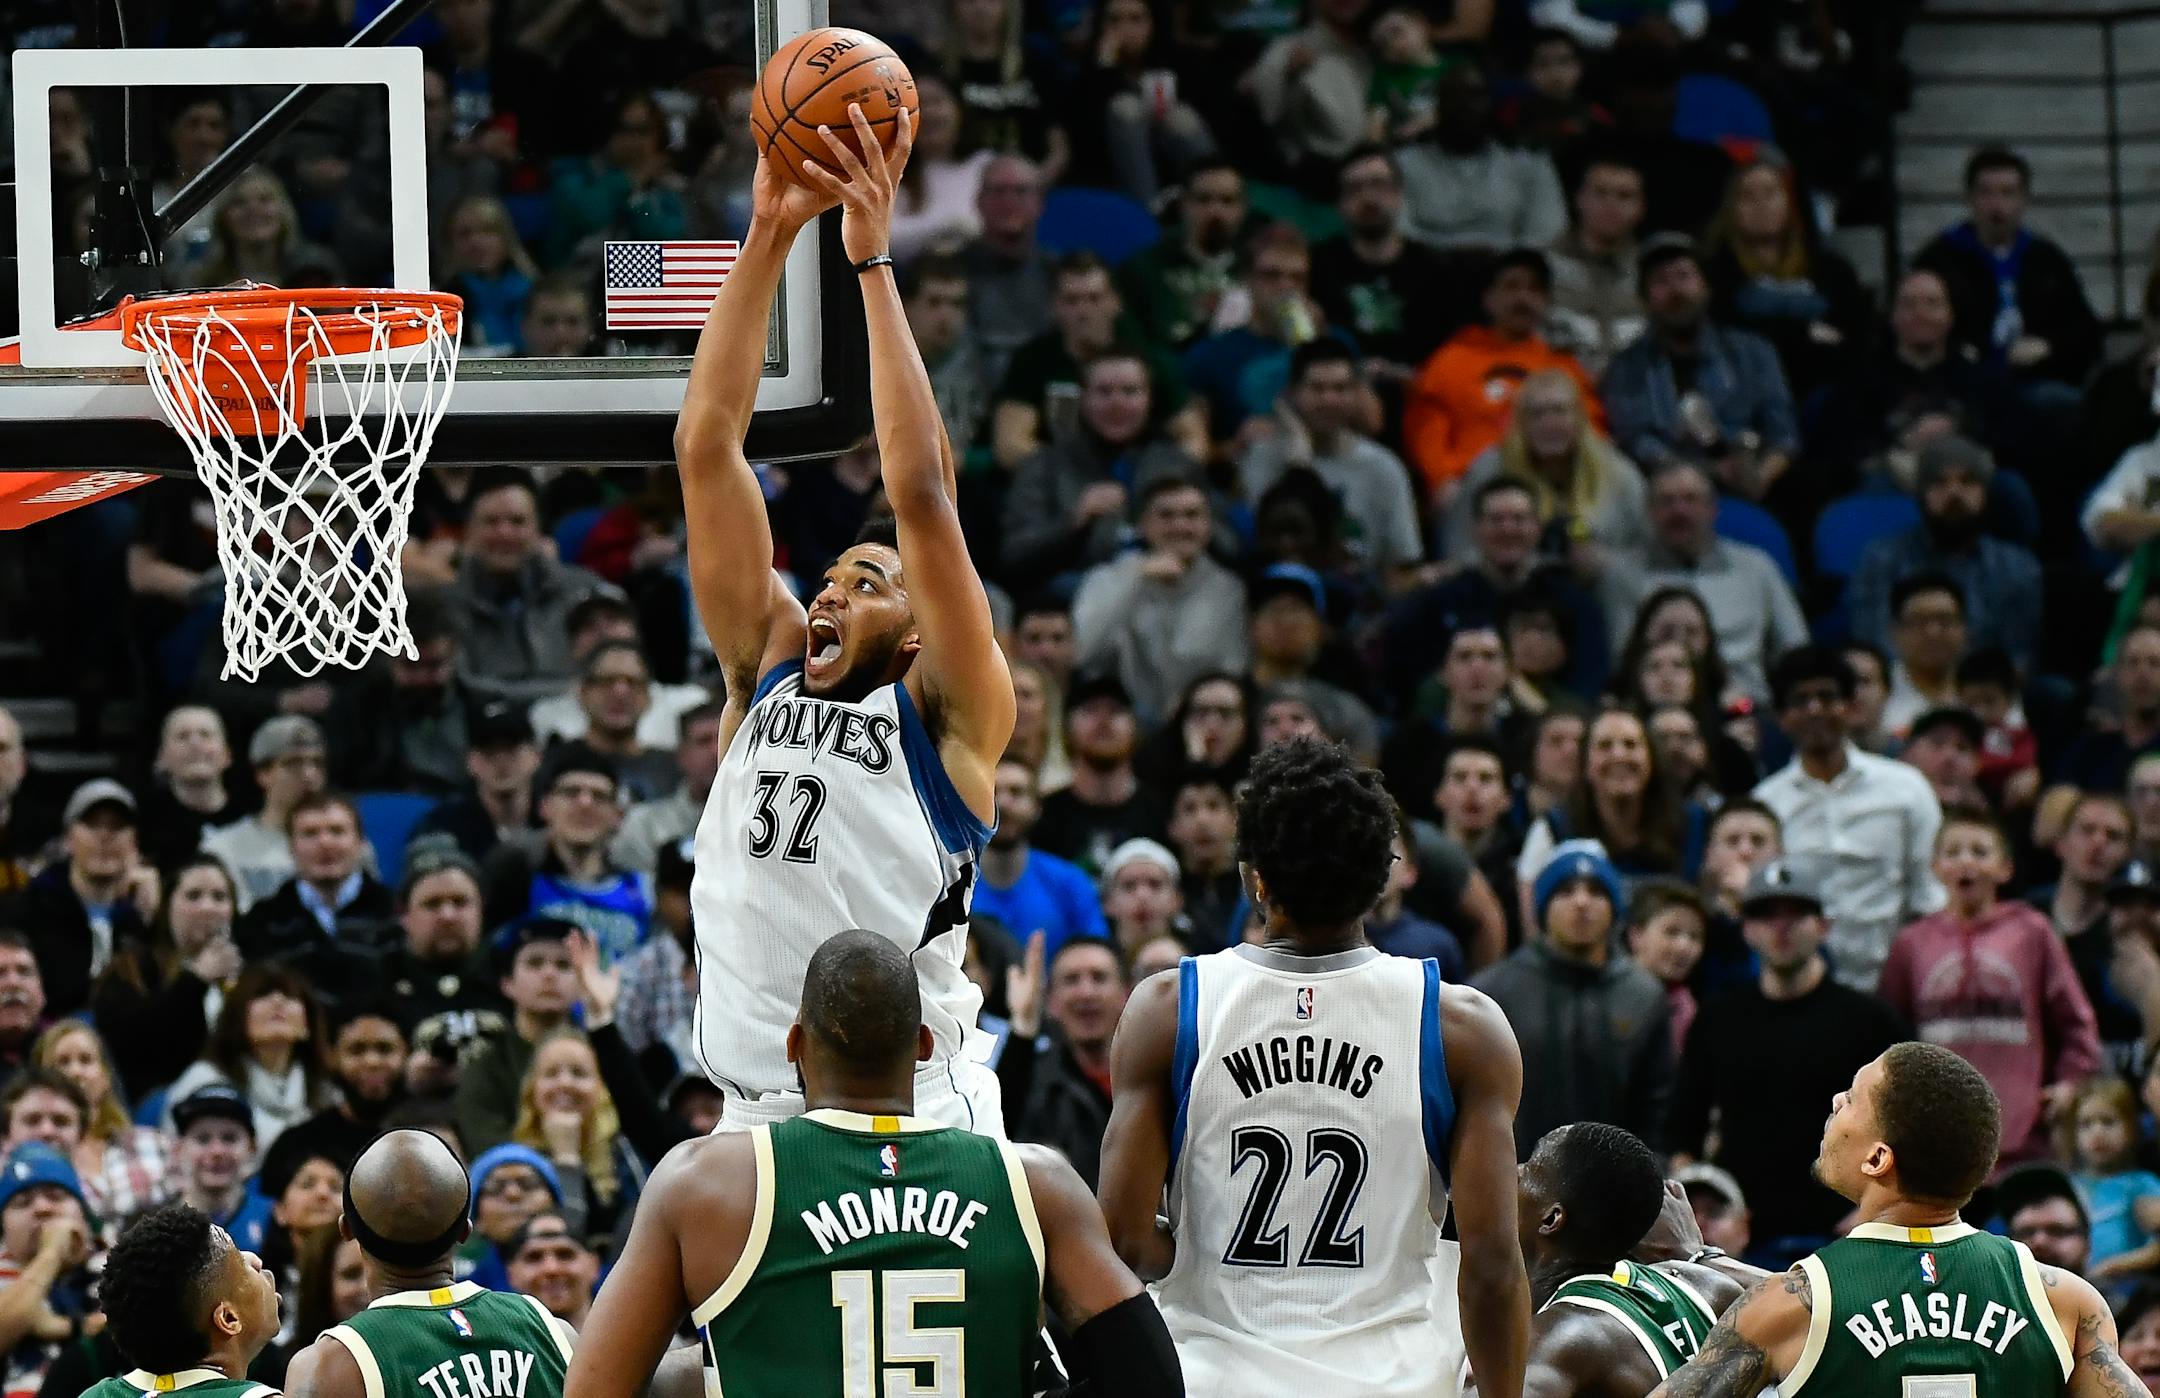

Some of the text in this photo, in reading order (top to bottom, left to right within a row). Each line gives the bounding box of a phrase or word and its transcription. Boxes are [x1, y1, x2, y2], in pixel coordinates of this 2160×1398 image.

[212, 391, 290, 411] PALIN
[743, 697, 899, 775] WOLVES
[749, 771, 827, 864] 32
[1222, 1035, 1384, 1099] WIGGINS
[801, 1187, 989, 1255] MONROE
[1221, 1125, 1369, 1268] 22
[831, 1269, 966, 1398] 15
[1845, 1292, 2029, 1359] BEASLEY
[417, 1350, 534, 1398] TERRY
